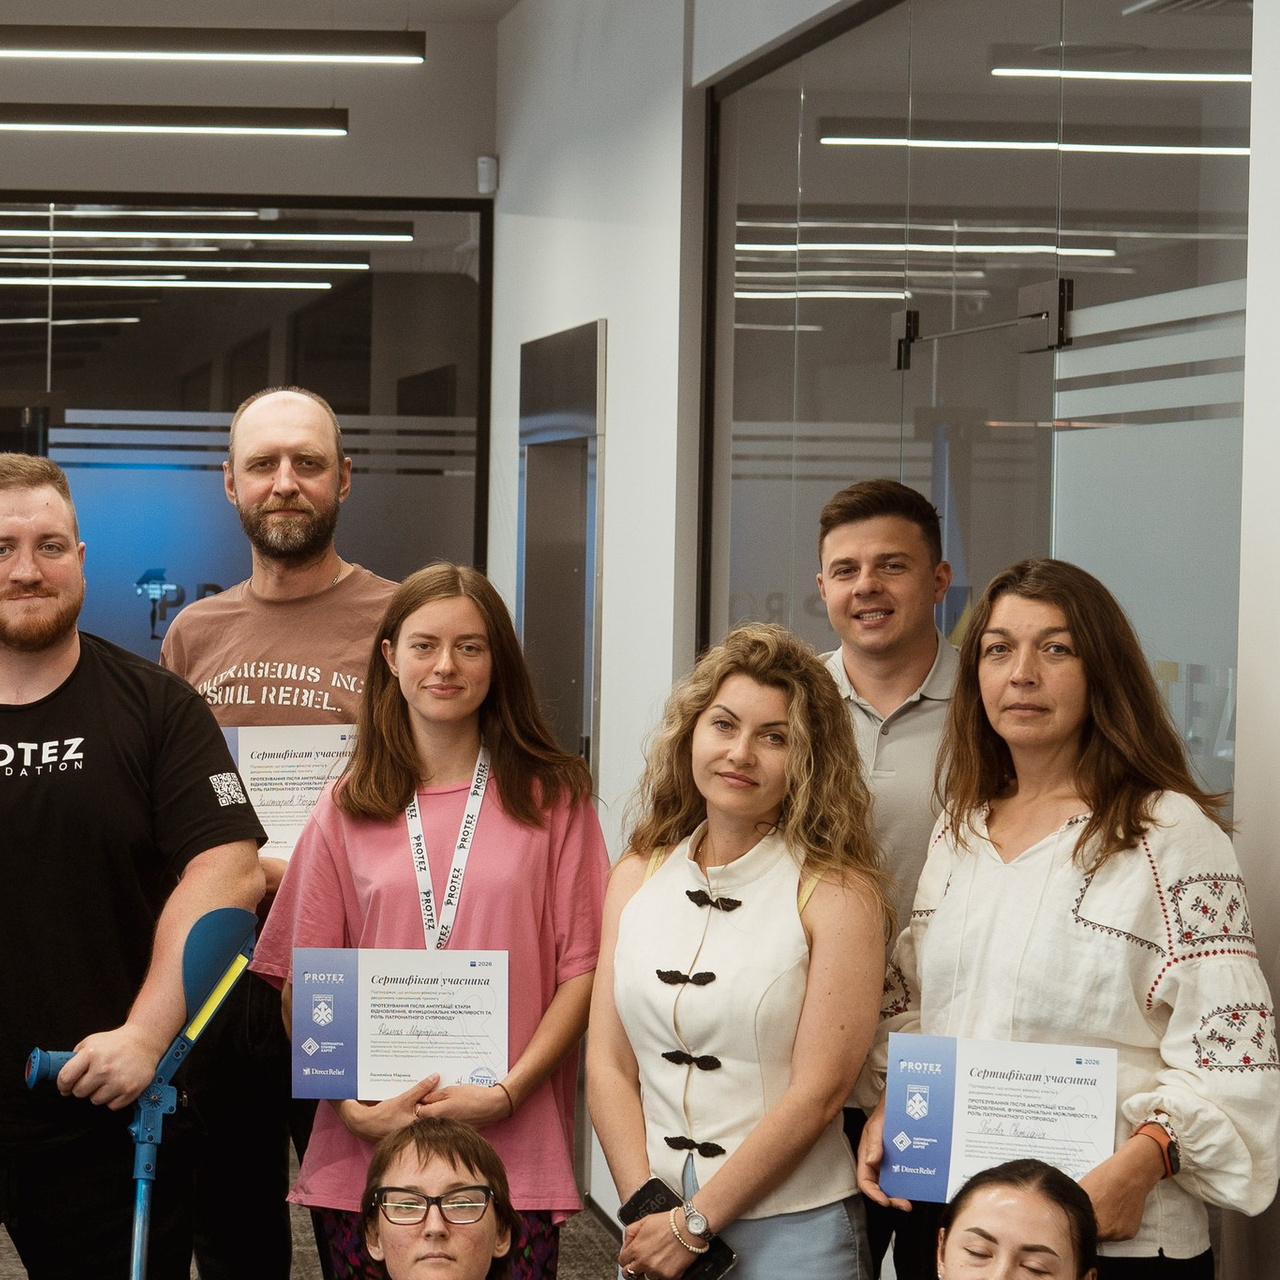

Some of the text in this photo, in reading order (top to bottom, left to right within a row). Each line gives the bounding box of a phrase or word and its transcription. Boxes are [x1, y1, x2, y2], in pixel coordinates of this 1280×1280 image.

[198, 661, 321, 695] OUTRAGEOUS
[206, 685, 256, 705] SOUL
[250, 749, 313, 761] Сертифікат
[473, 762, 486, 797] PROTEZ
[459, 813, 475, 850] PROTEZ
[413, 835, 427, 872] PROTEZ
[446, 867, 461, 906] PROTEZ
[423, 891, 435, 930] PROTEZ
[304, 972, 343, 981] PROTEZ
[371, 975, 489, 986] Сертифікат учасника
[900, 1059, 941, 1071] PROTEZ
[969, 1068, 1096, 1085] Сертифікат учасника
[901, 1165, 918, 1173] Direct
